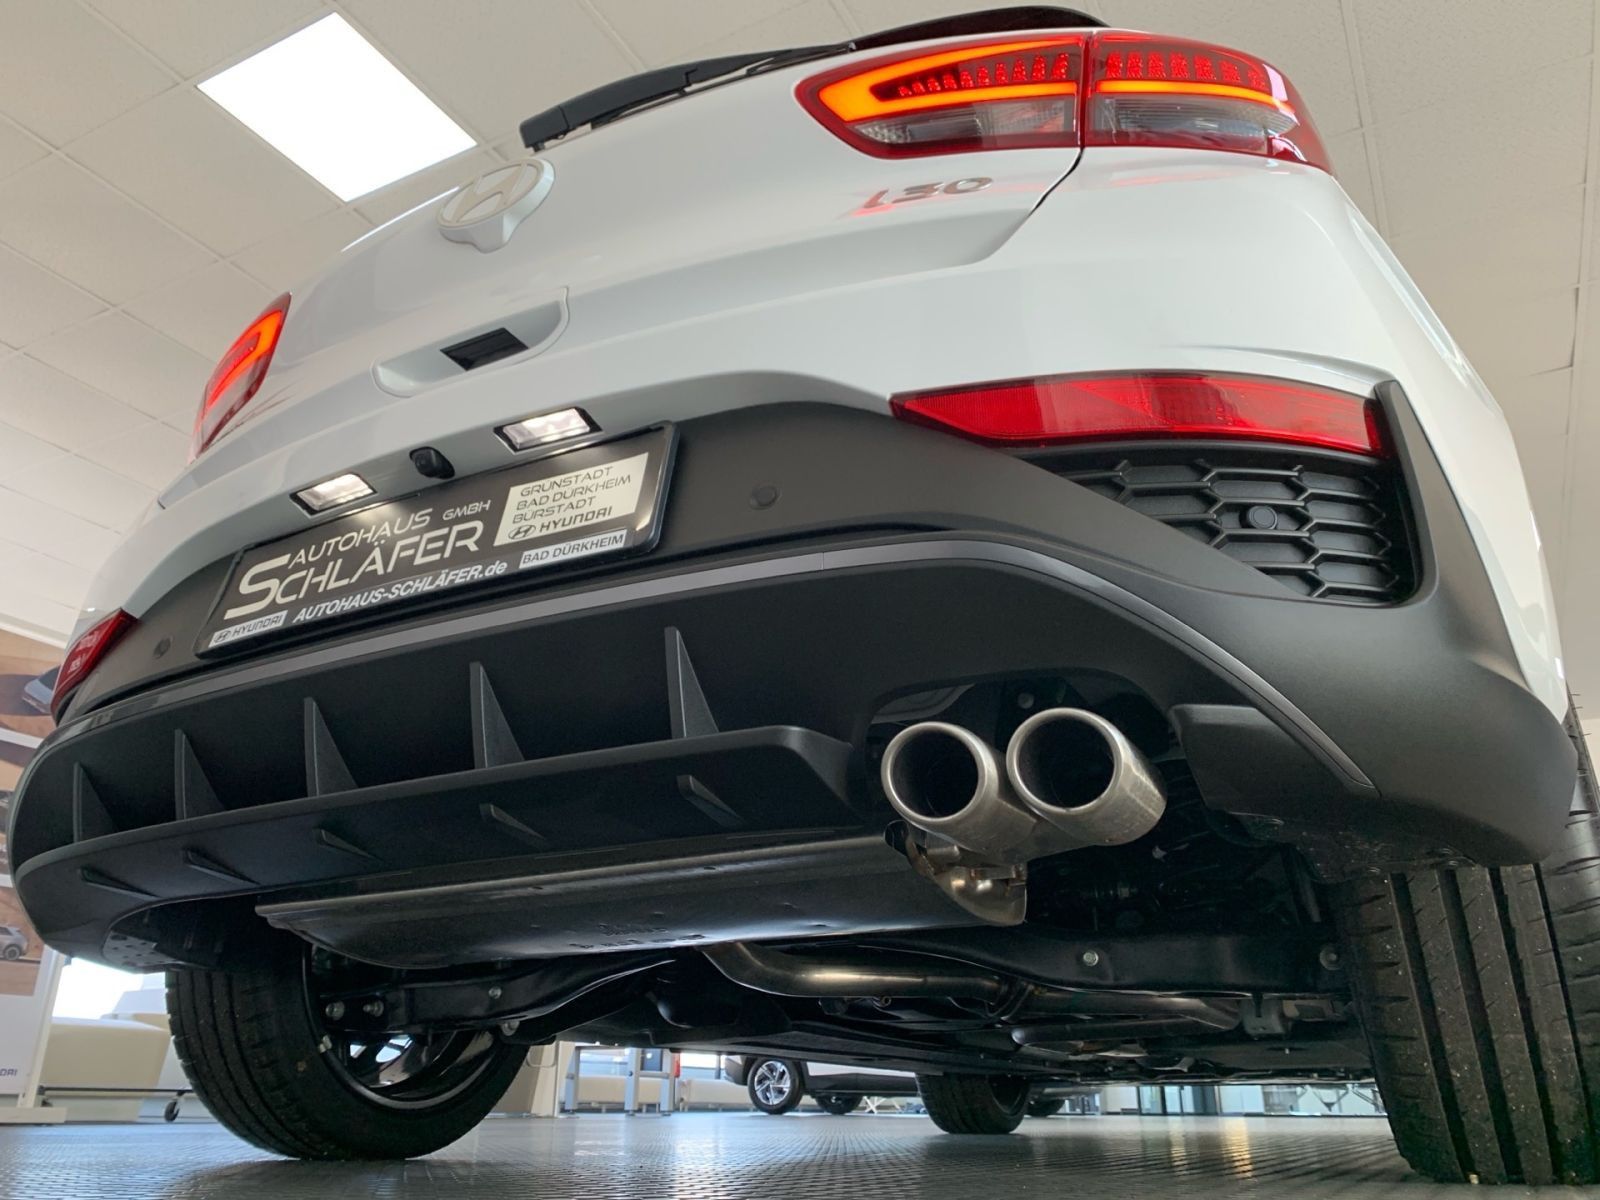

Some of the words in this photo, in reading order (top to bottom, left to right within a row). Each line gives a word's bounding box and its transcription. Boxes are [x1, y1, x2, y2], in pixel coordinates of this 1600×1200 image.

[516, 494, 550, 511] BAD
[552, 474, 631, 502] DÜRKHEIM
[512, 496, 596, 524] BÜRSTADT
[539, 506, 613, 533] HYUNDAI
[288, 508, 434, 569] AUTOHAUS
[442, 500, 492, 521] GMBH
[522, 550, 550, 565] BAD
[552, 534, 624, 558] DÜRKHEIM
[224, 520, 484, 620] SCHLÄFER
[292, 560, 508, 623] AUTOHAUS-SCHLÄFER.de
[232, 613, 284, 637] HYUNDAI
